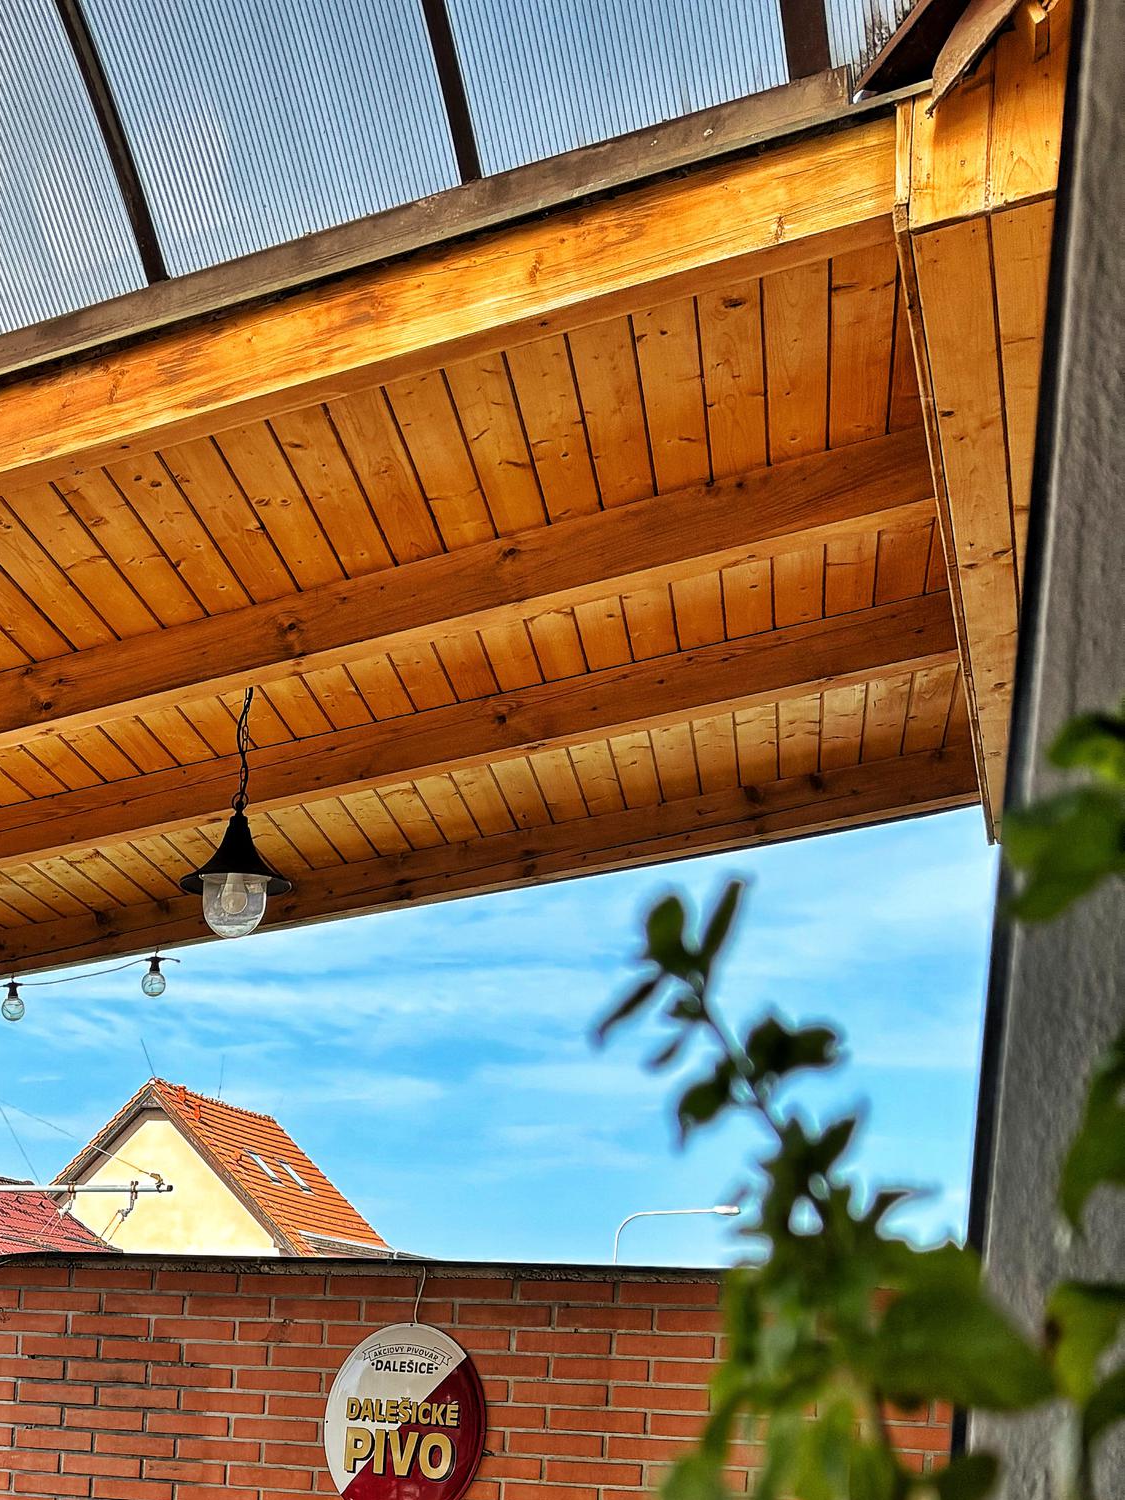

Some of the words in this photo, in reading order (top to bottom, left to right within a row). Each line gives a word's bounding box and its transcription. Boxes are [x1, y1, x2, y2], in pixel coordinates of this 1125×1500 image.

[374, 1346, 405, 1358] AKCIOVÝ
[406, 1346, 439, 1361] PIVOVAR
[346, 1397, 459, 1428] DALEŠICKÉ
[344, 1427, 457, 1482] PIVO
